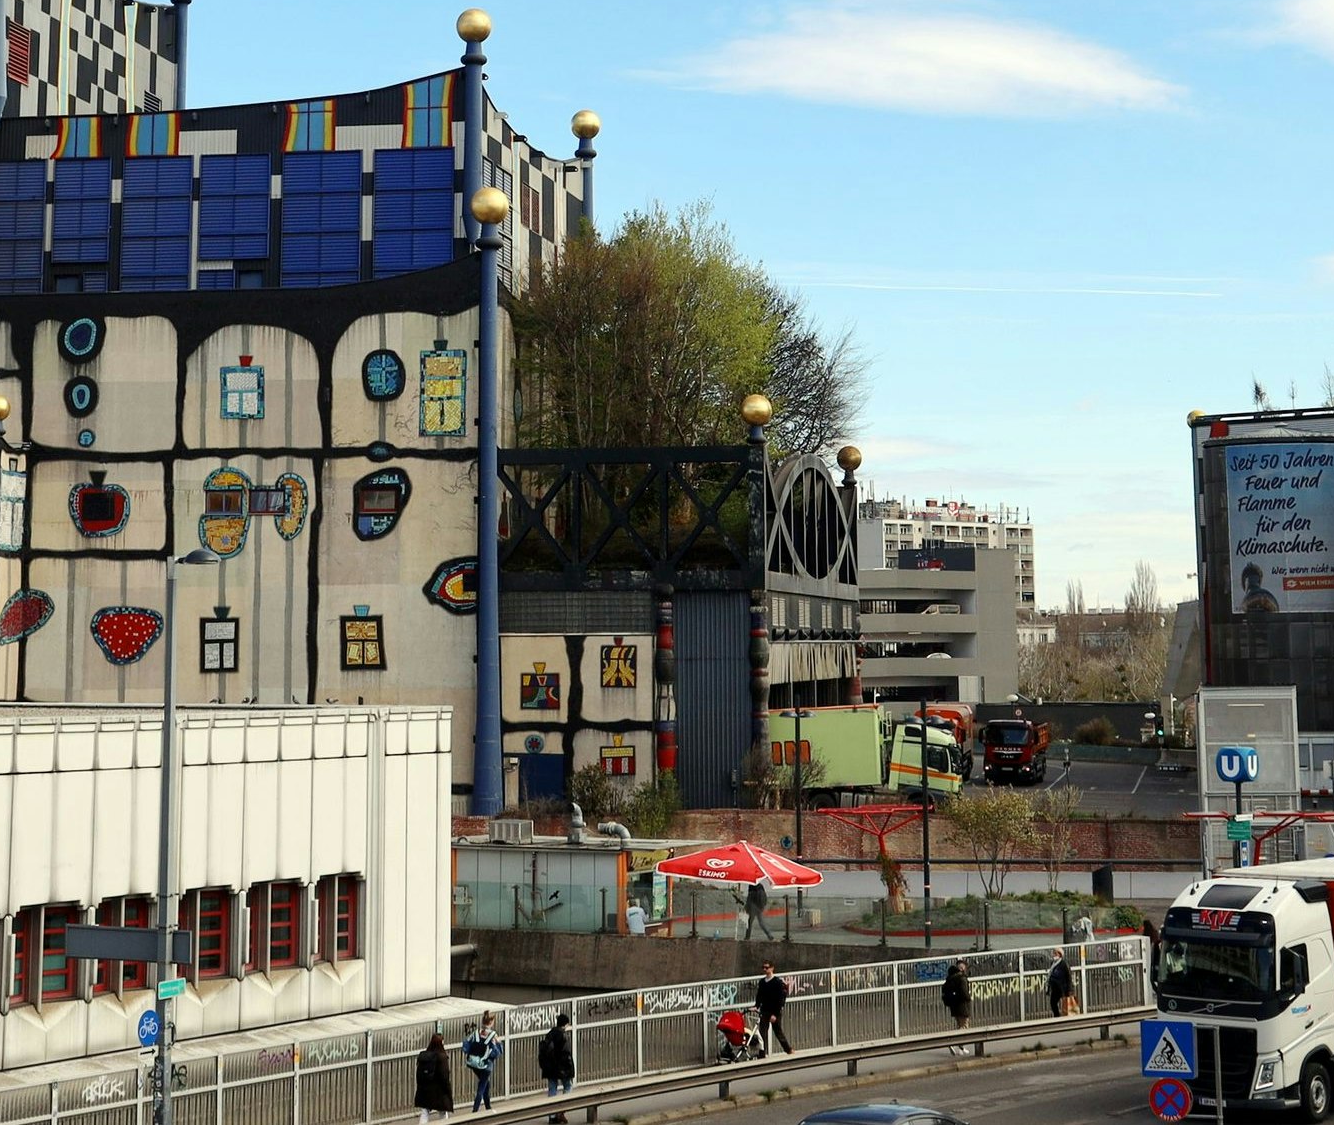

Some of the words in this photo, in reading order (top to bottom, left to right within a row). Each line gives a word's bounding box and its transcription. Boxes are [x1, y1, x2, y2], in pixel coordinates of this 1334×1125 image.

[1230, 453, 1257, 472] Seit
[1259, 454, 1279, 469] 50
[1283, 448, 1333, 469] Jahren
[1245, 475, 1288, 491] Feuer
[1291, 469, 1323, 489] und
[1237, 495, 1297, 512] Flamme
[1256, 515, 1279, 536] für
[1282, 512, 1311, 531] den
[1236, 534, 1328, 557] Klimaschutz.
[1289, 566, 1309, 574] wenn
[1310, 563, 1329, 573] nicht
[1221, 755, 1240, 778] U
[1247, 754, 1258, 778] U
[698, 868, 727, 879] ESKIMO
